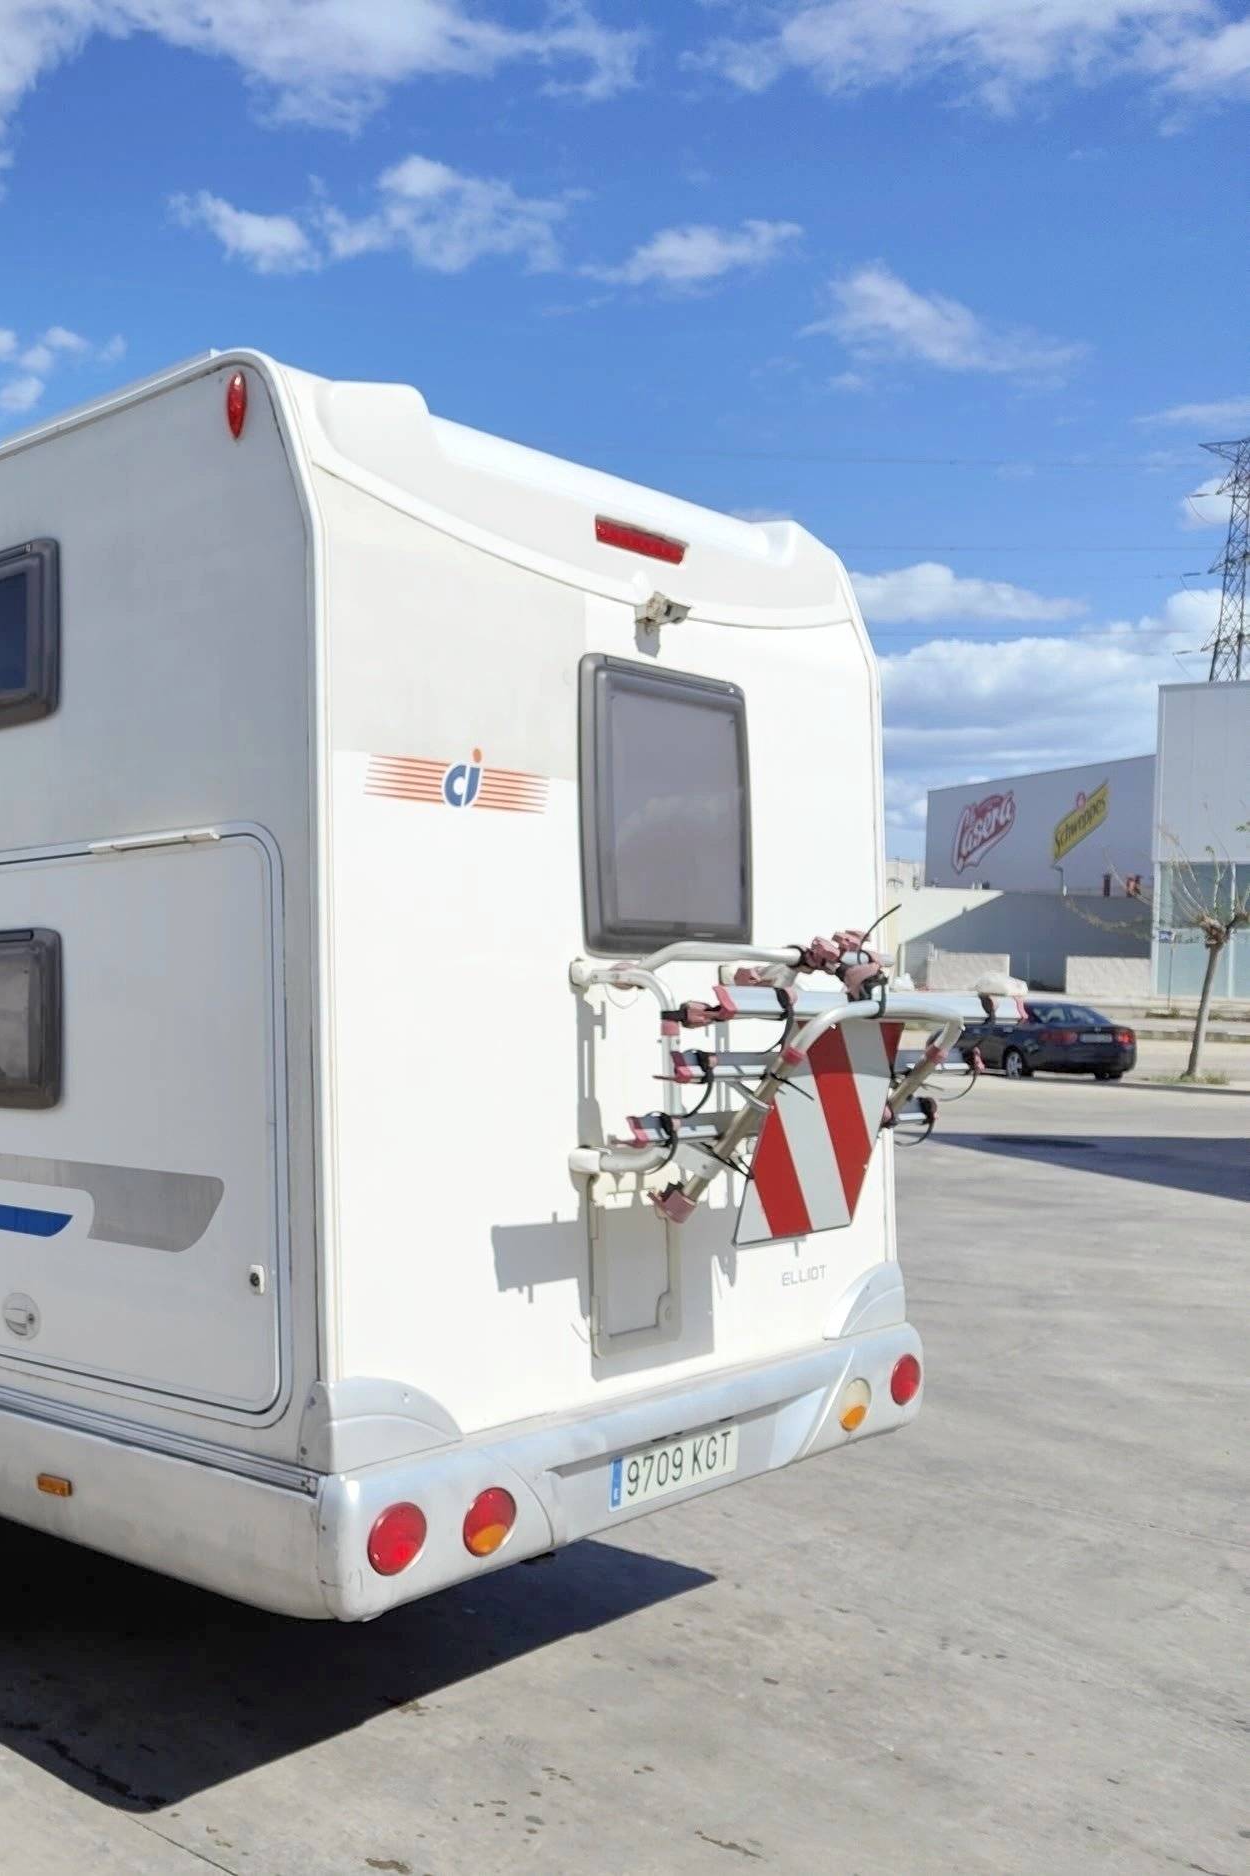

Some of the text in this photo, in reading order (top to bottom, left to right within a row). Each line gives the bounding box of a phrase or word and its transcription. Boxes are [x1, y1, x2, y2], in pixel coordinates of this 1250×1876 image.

[782, 1264, 827, 1287] ELLIOT
[626, 1430, 732, 1497] 9709 KGT
